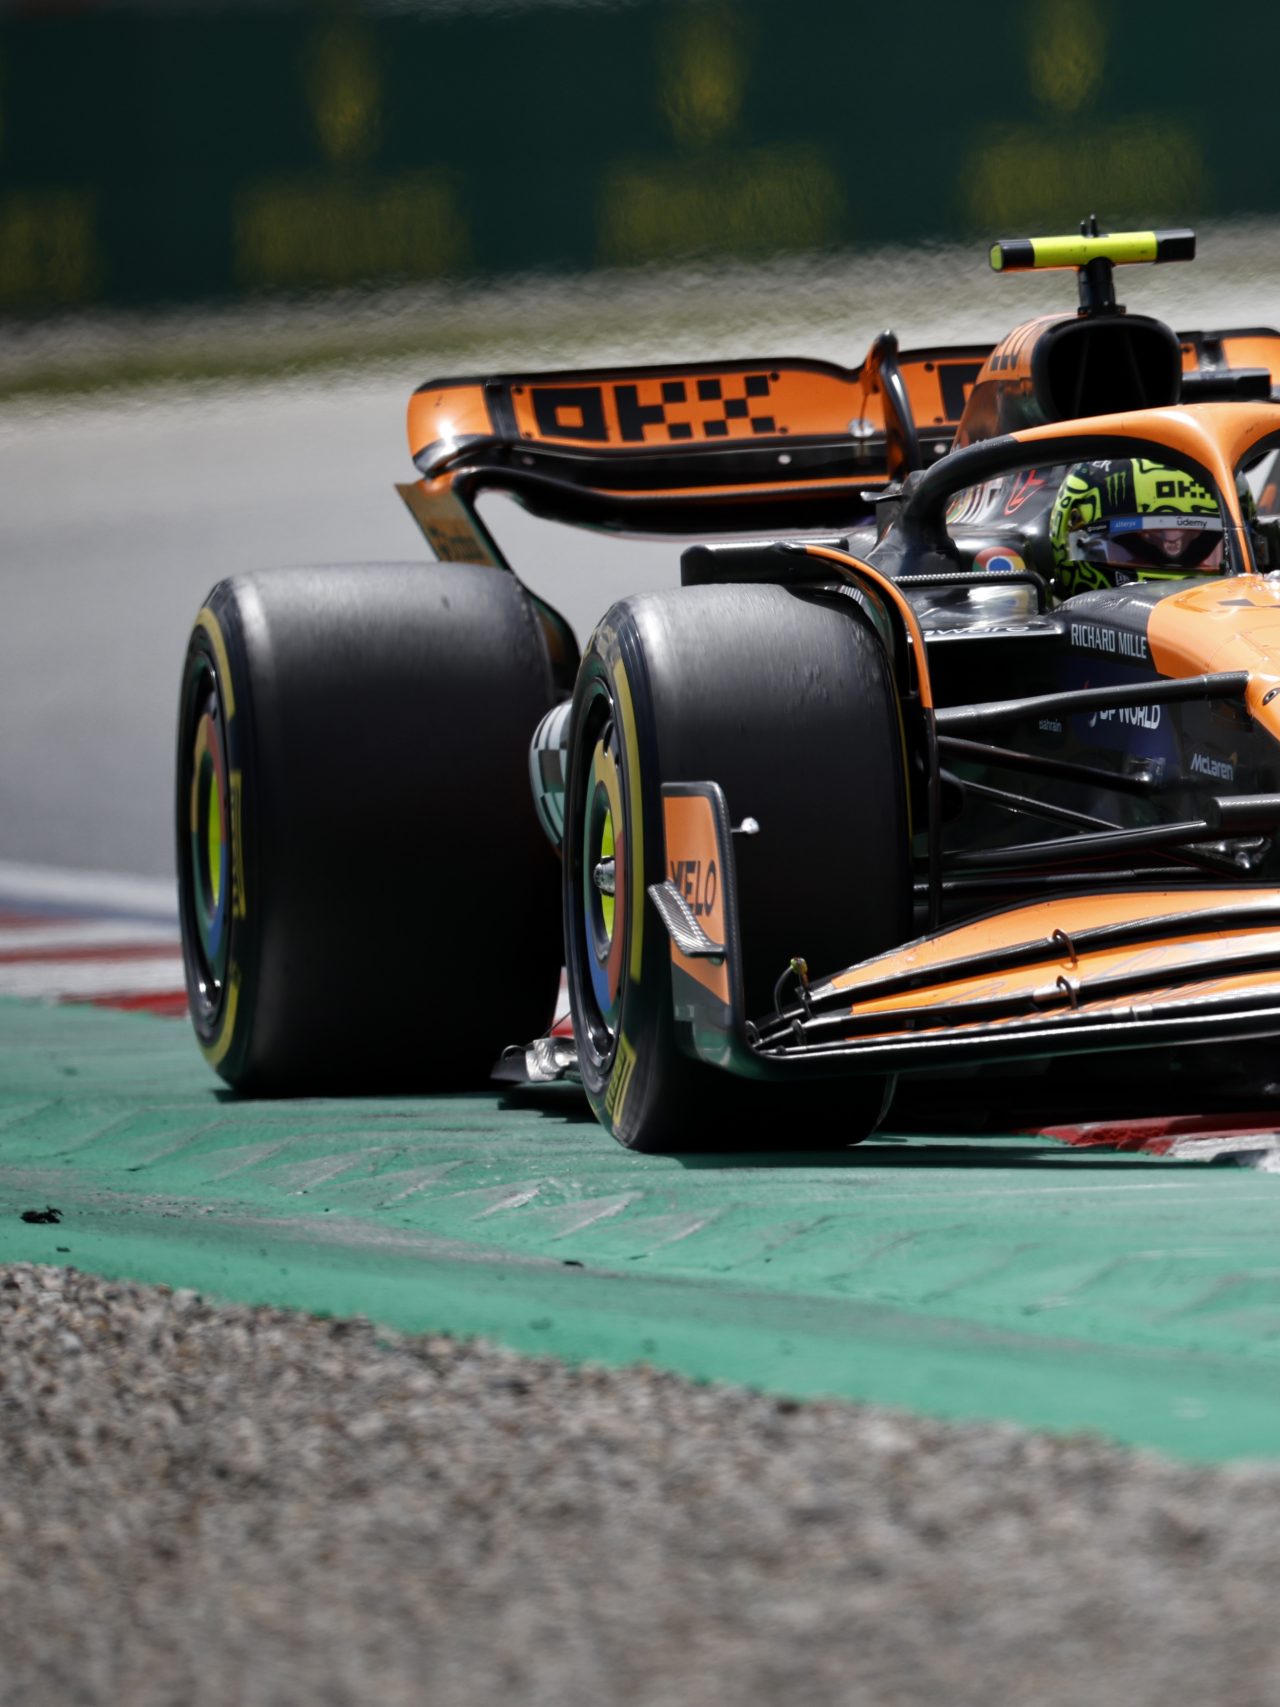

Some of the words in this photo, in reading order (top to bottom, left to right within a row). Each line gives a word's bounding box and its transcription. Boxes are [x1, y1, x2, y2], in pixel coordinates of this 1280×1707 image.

[532, 376, 776, 442] OKX
[1071, 623, 1116, 653] RICHARD
[1118, 632, 1147, 660] MILLE
[1191, 754, 1233, 781] McLaren
